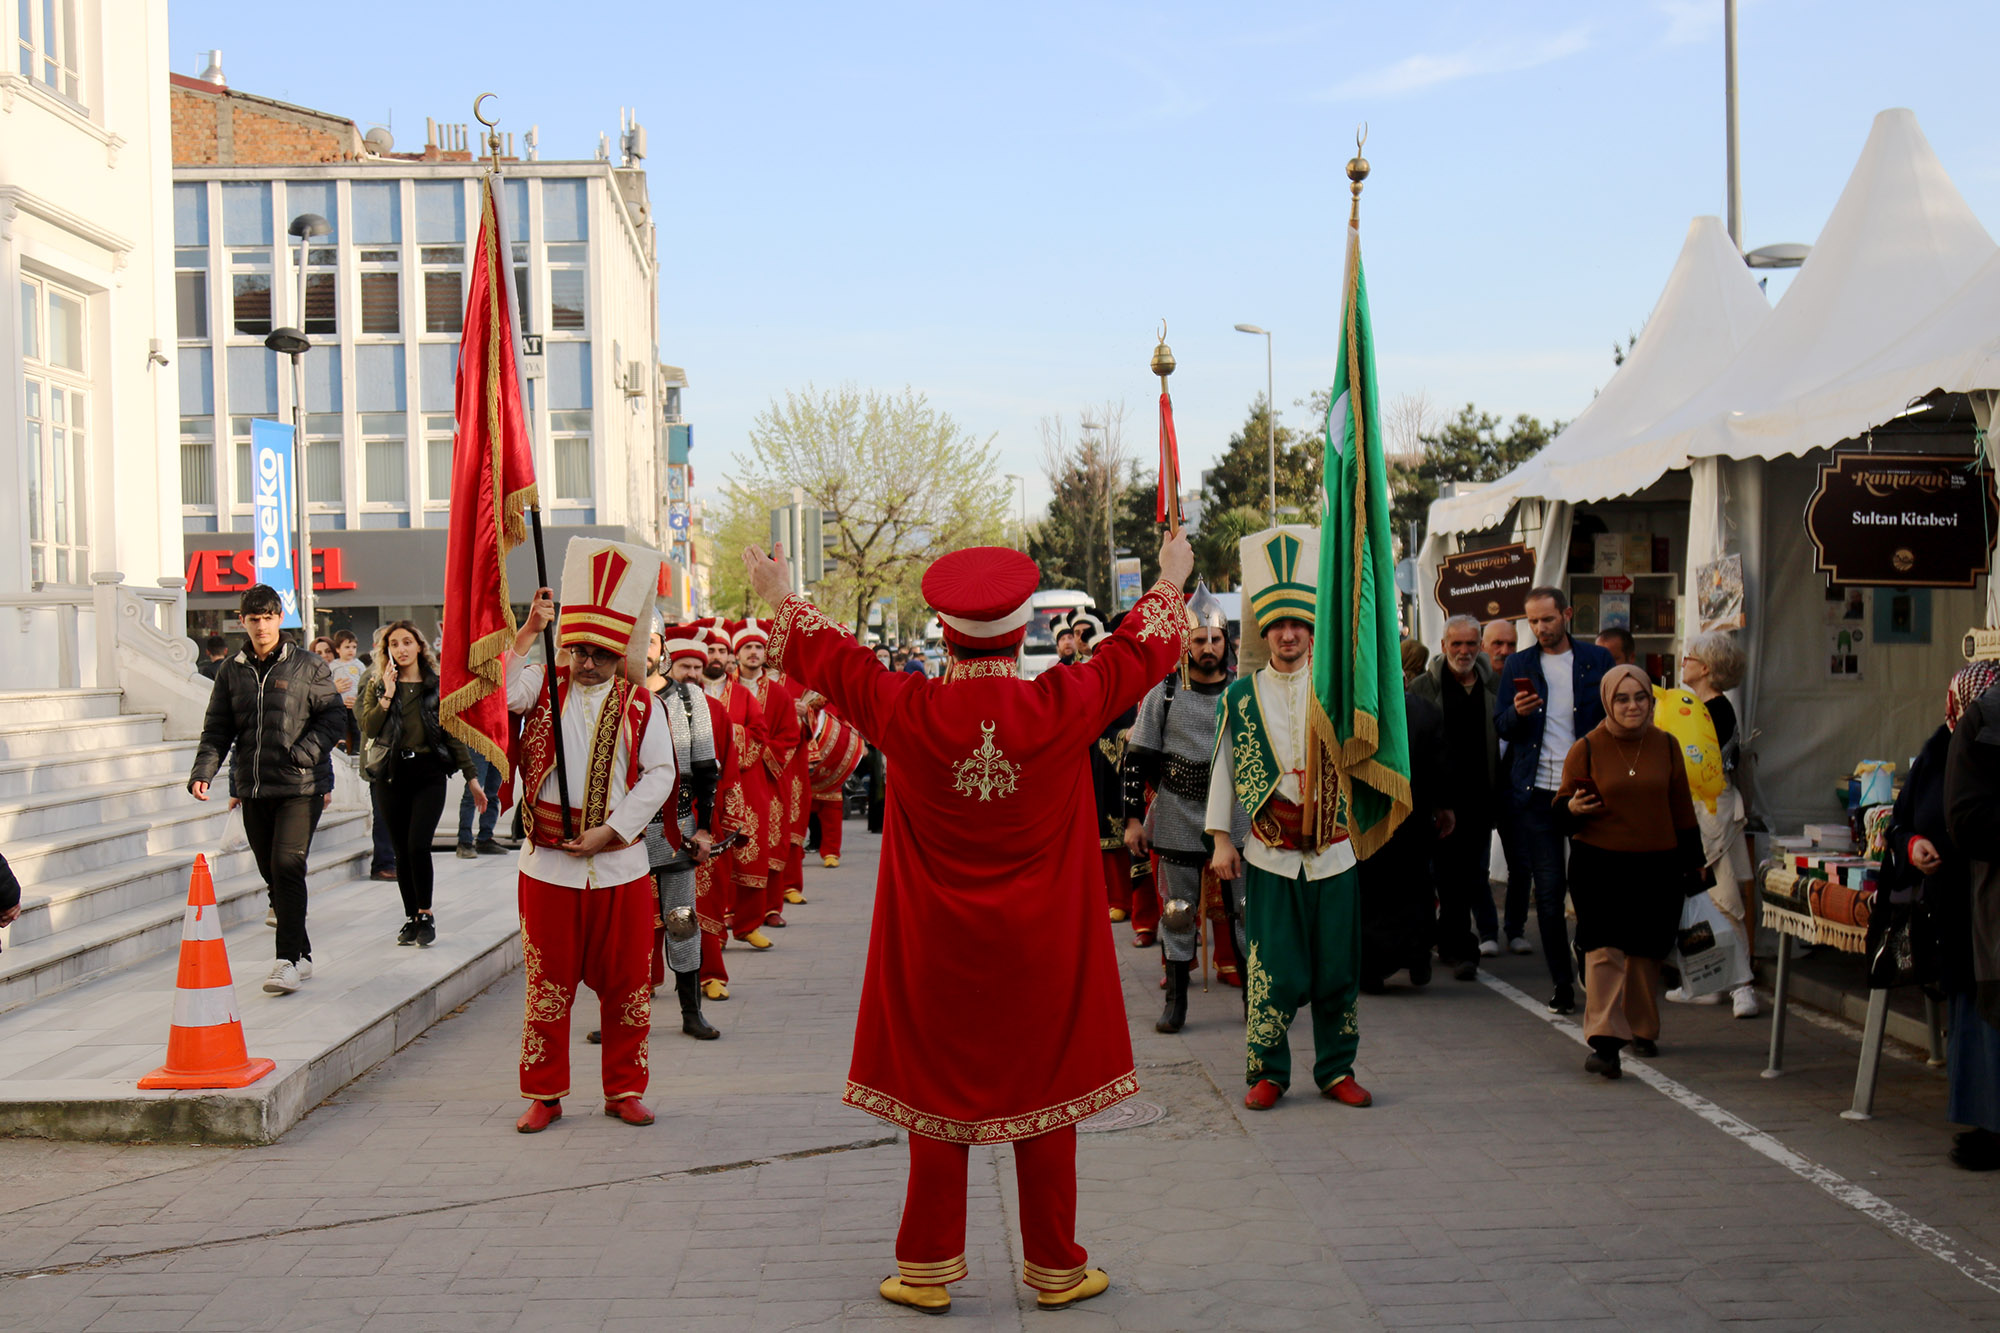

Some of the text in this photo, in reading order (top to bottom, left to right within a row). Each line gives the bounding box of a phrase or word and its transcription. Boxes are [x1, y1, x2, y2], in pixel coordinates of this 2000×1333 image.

[1851, 471, 1946, 497] Ramazan
[256, 447, 280, 568] beko
[1852, 511, 1958, 526] Sultan Kitabevi
[185, 547, 357, 593] VESEL
[1450, 575, 1530, 596] Semerkand Yayınları
